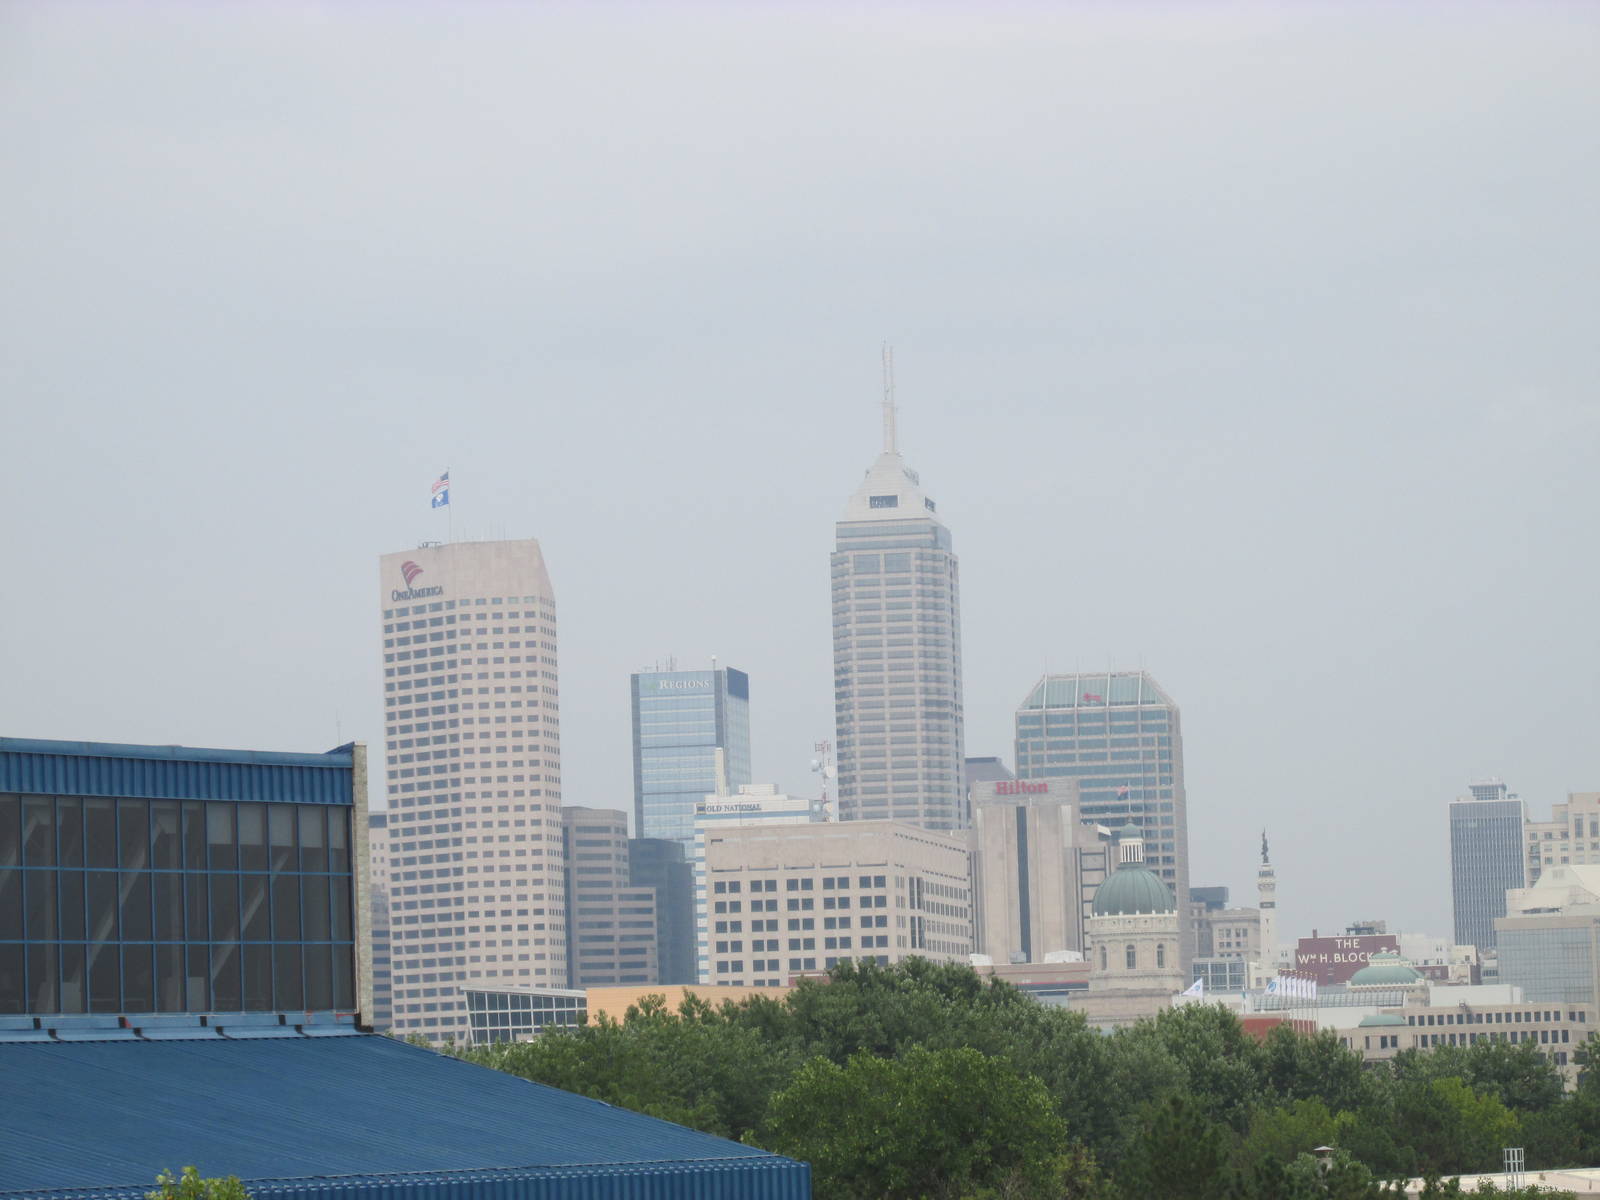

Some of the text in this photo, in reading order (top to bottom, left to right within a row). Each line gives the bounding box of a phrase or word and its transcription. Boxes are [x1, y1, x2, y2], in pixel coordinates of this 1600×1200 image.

[659, 679, 711, 689] REGIONS
[995, 779, 1048, 794] Hilton
[1336, 938, 1360, 949] THE
[1334, 952, 1374, 963] BLOCK
